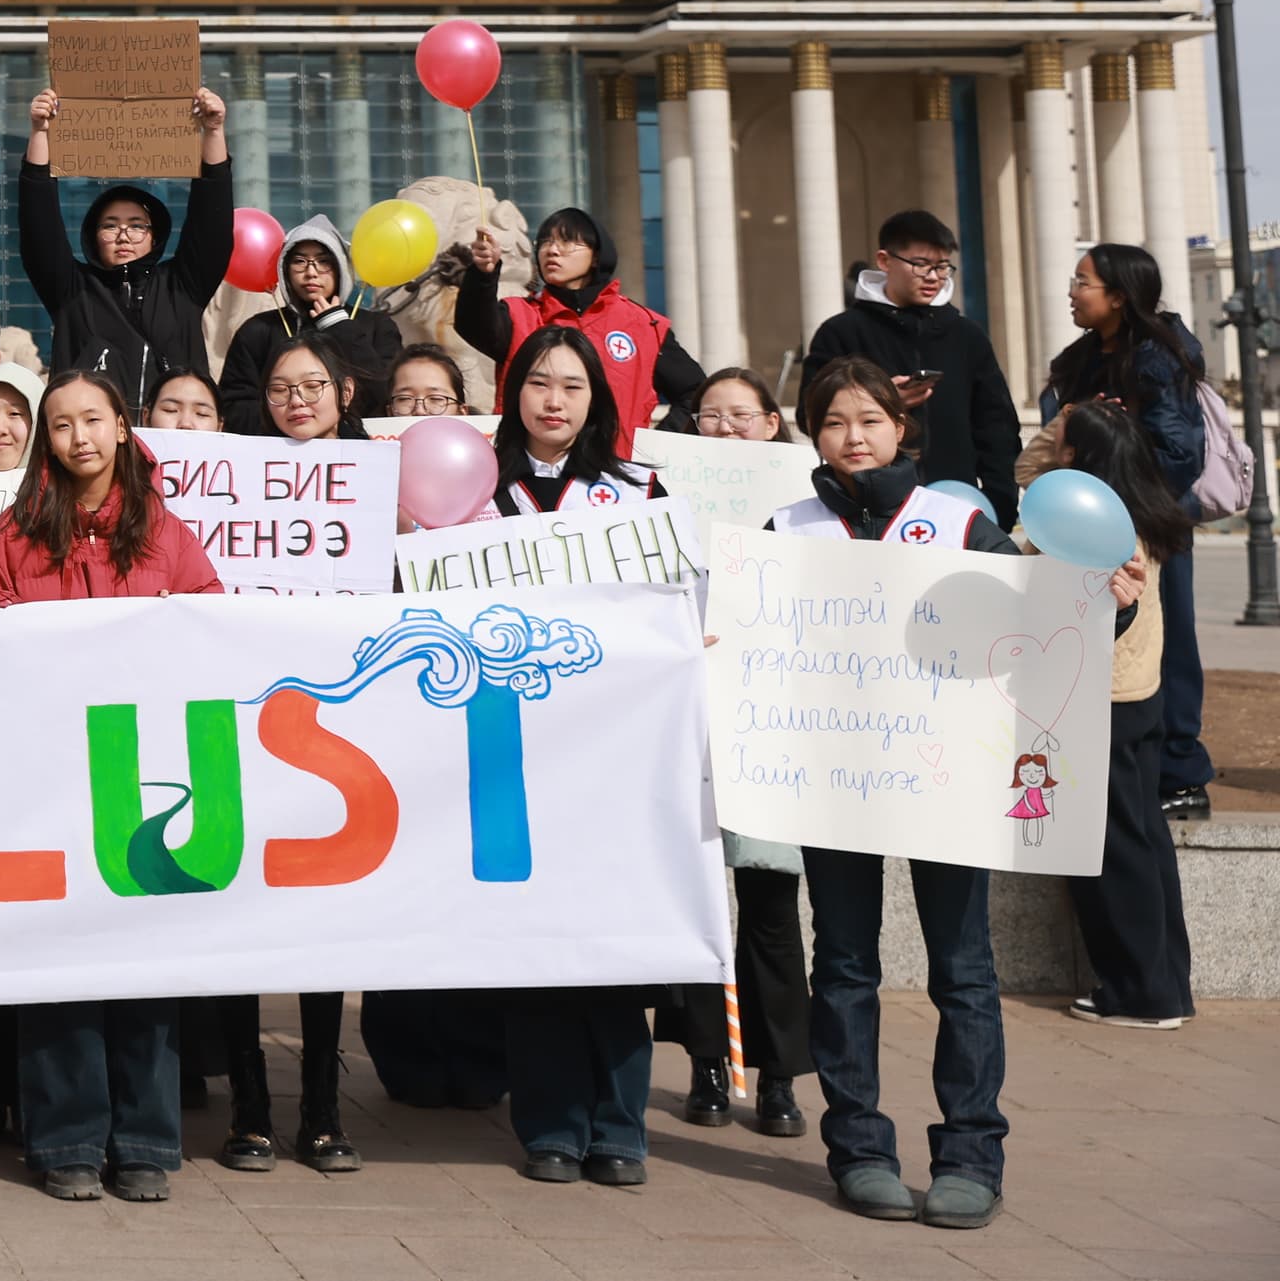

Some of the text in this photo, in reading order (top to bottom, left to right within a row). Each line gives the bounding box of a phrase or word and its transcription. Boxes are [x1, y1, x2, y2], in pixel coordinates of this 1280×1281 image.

[159, 459, 358, 505] БИД БИЕ
[183, 519, 352, 560] ИЕНЭЭ
